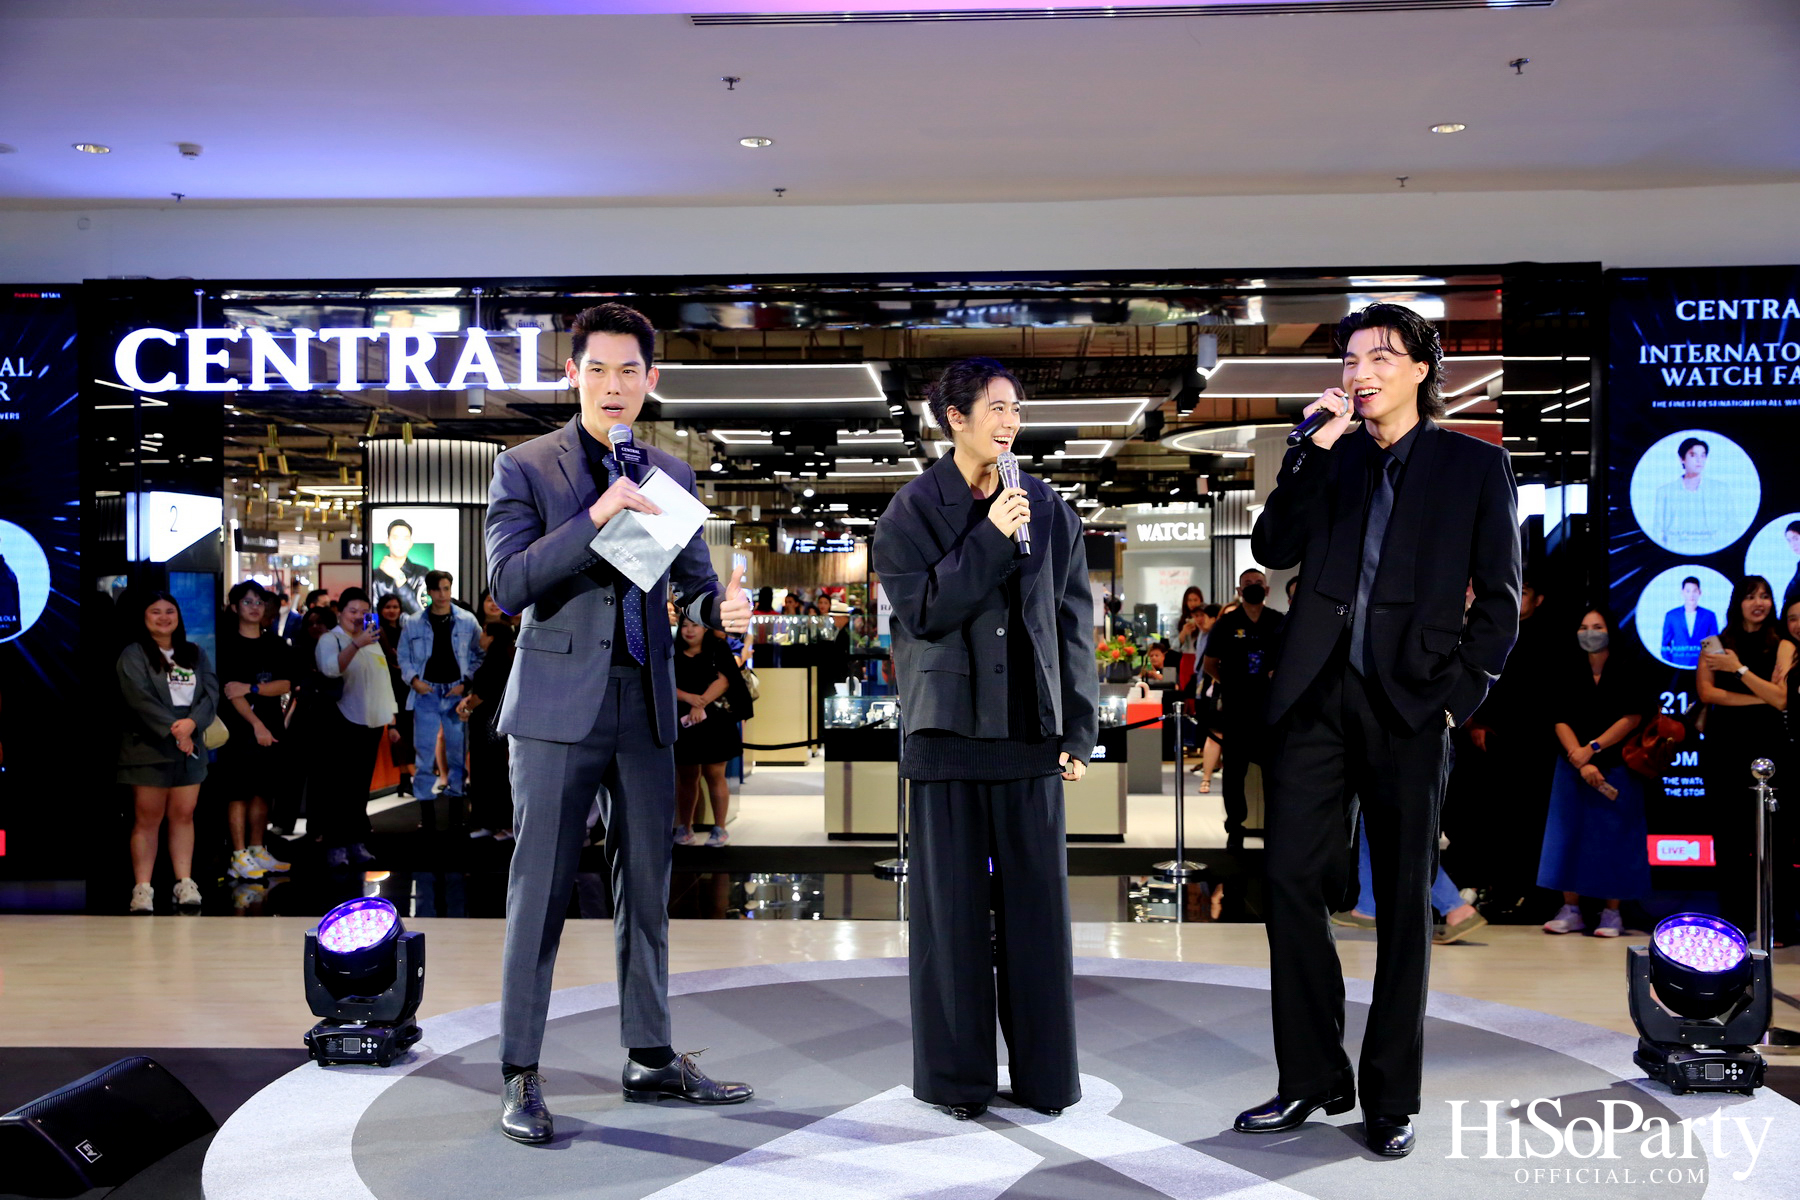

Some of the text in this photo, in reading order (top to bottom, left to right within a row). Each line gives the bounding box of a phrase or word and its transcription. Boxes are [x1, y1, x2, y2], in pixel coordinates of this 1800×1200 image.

[114, 327, 569, 392] CENTRAL
[1661, 366, 1763, 387] WATCH
[169, 505, 179, 533] 2
[1136, 522, 1206, 542] WATCH
[1662, 776, 1680, 785] THE
[1664, 788, 1682, 797] THE
[1661, 846, 1686, 855] LIVE
